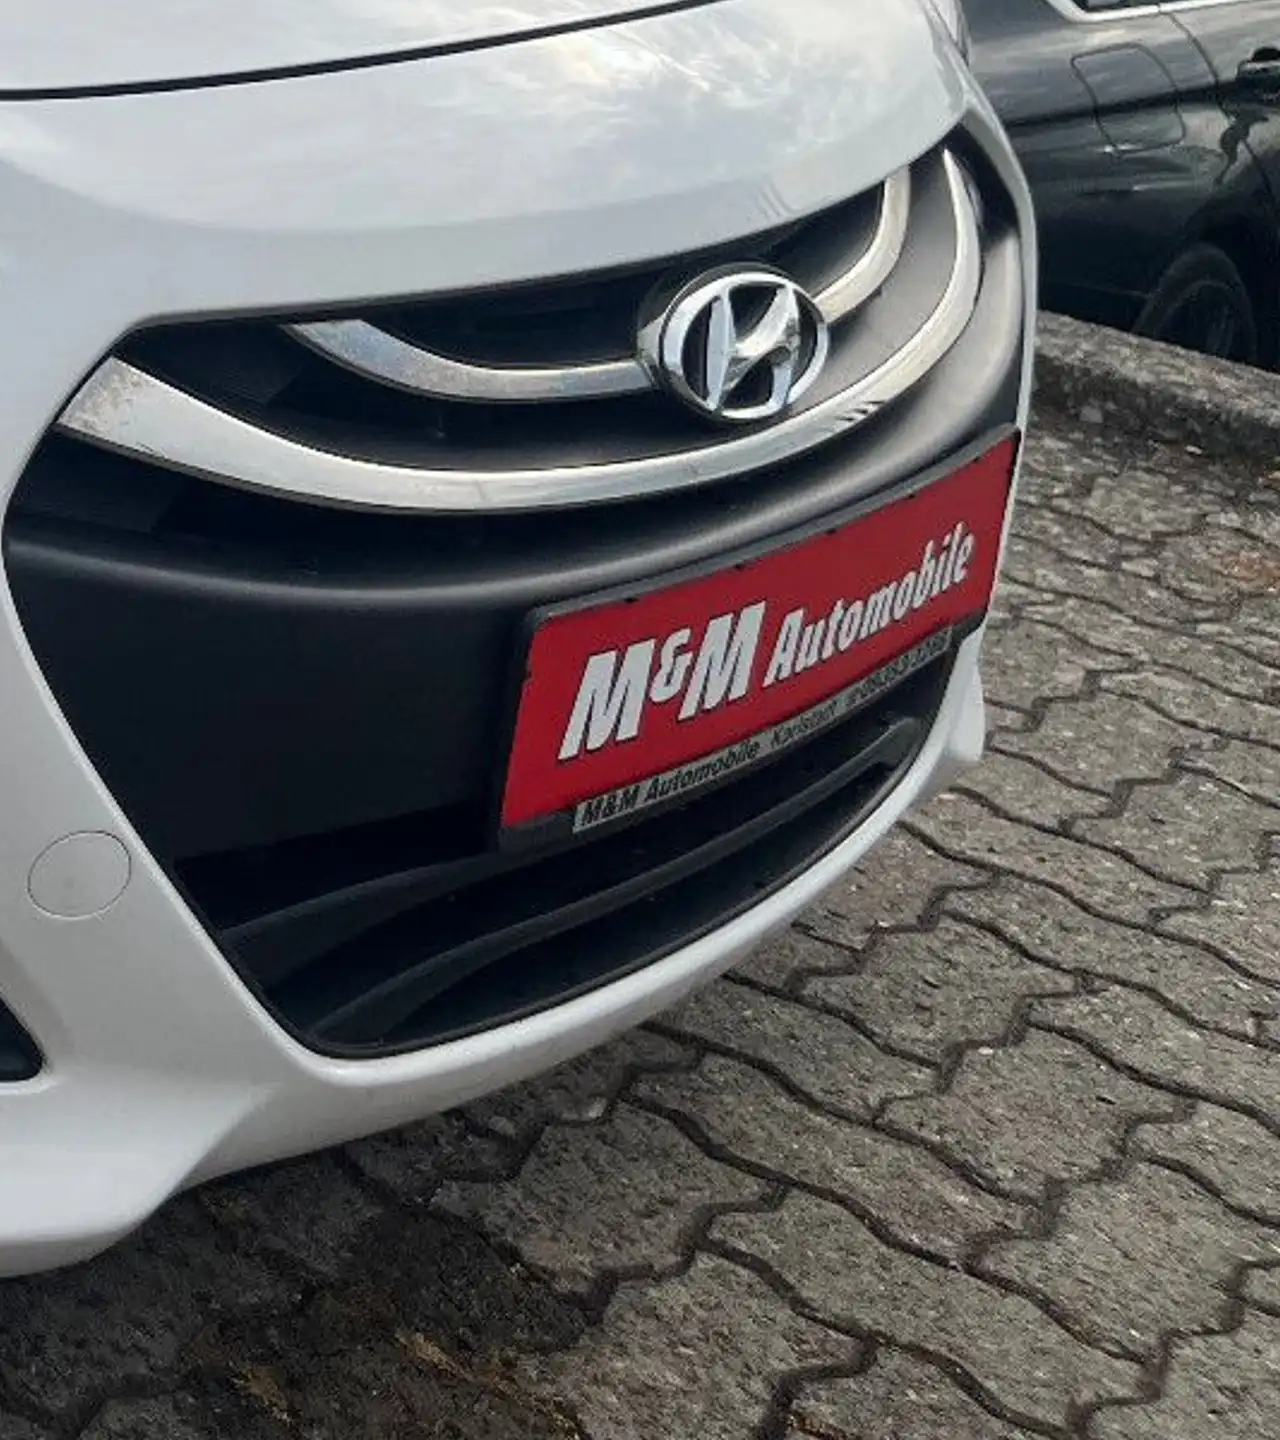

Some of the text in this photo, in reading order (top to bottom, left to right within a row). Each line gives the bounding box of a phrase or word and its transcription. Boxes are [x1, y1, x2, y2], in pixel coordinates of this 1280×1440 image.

[557, 600, 767, 761] M&M
[762, 521, 977, 688] Automobile
[581, 784, 640, 827] M&M
[643, 740, 761, 803] Automobile
